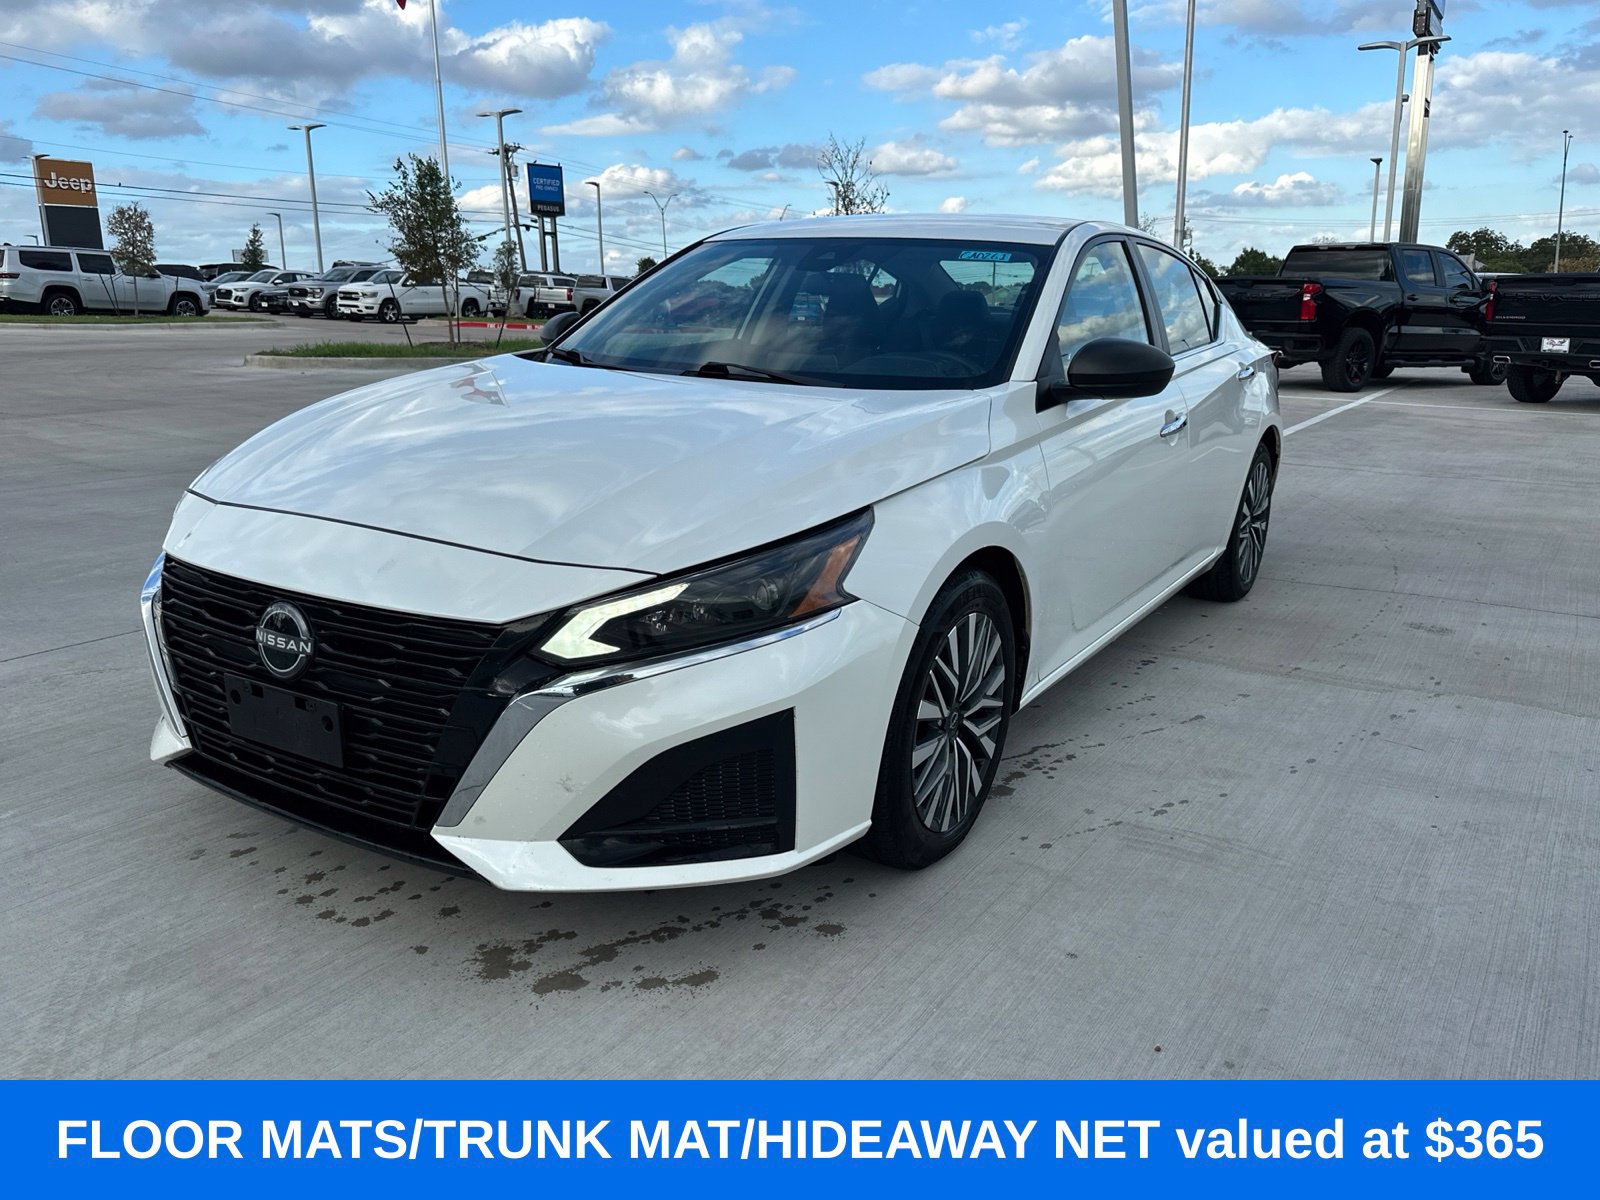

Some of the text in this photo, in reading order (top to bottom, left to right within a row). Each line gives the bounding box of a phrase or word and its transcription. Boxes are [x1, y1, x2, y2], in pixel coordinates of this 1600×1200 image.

[44, 171, 93, 194] Jeep
[532, 177, 561, 187] CERTIFIED
[537, 204, 560, 212] PEGASUS
[255, 629, 312, 653] NISSAN
